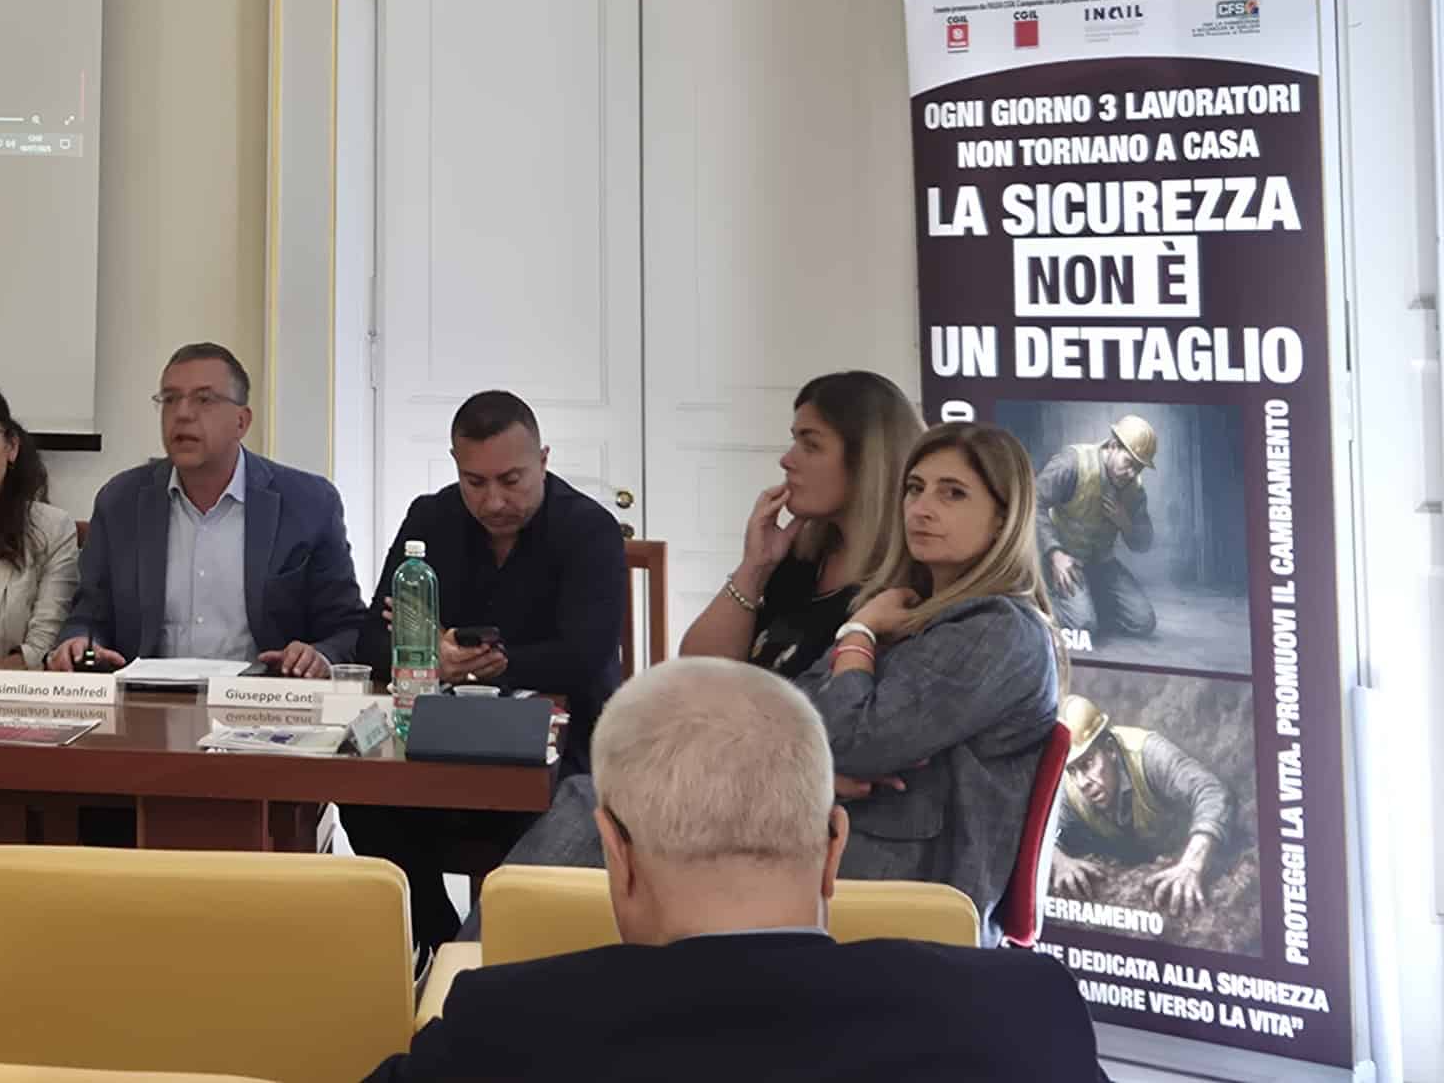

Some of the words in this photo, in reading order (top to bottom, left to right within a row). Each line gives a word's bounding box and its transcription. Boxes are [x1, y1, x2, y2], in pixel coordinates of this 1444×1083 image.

[946, 15, 968, 25] CGIL
[1013, 10, 1039, 21] CGIL
[1084, 5, 1144, 21] INAIL
[1218, 2, 1246, 17] CFS
[924, 99, 985, 130] OGNI
[991, 93, 1092, 127] GIORNO
[1098, 97, 1117, 122] 3
[1125, 83, 1301, 119] LAVORATORI
[956, 139, 1014, 169] NON
[1019, 133, 1149, 166] TORNANO
[1155, 133, 1176, 162] A
[1182, 128, 1261, 161] CASA
[927, 185, 988, 237] LA
[1001, 175, 1302, 237] SICUREZZA
[1027, 254, 1135, 305] NON
[1157, 240, 1188, 306] È
[930, 326, 997, 378] UN
[1014, 326, 1304, 384] DETTAGLIO
[1264, 398, 1296, 576] CAMBIAMENTO
[1271, 580, 1296, 605] IL
[1060, 628, 1093, 652] SIA
[52, 685, 108, 699] Manfredi
[1272, 608, 1301, 737] PROMUOVI
[225, 688, 282, 705] Giuseppe
[284, 690, 316, 704] Cant
[1277, 742, 1303, 802] VITA.
[1279, 806, 1305, 840] LA
[1044, 895, 1164, 935] ERRAMENTO
[1281, 843, 1310, 966] PROTEGGI
[1068, 947, 1160, 983] DEDICATA
[1163, 963, 1213, 993] ALLA
[1217, 974, 1331, 1013] SICUREZZA
[1149, 991, 1215, 1023] VERSO
[1218, 1004, 1247, 1029] LA
